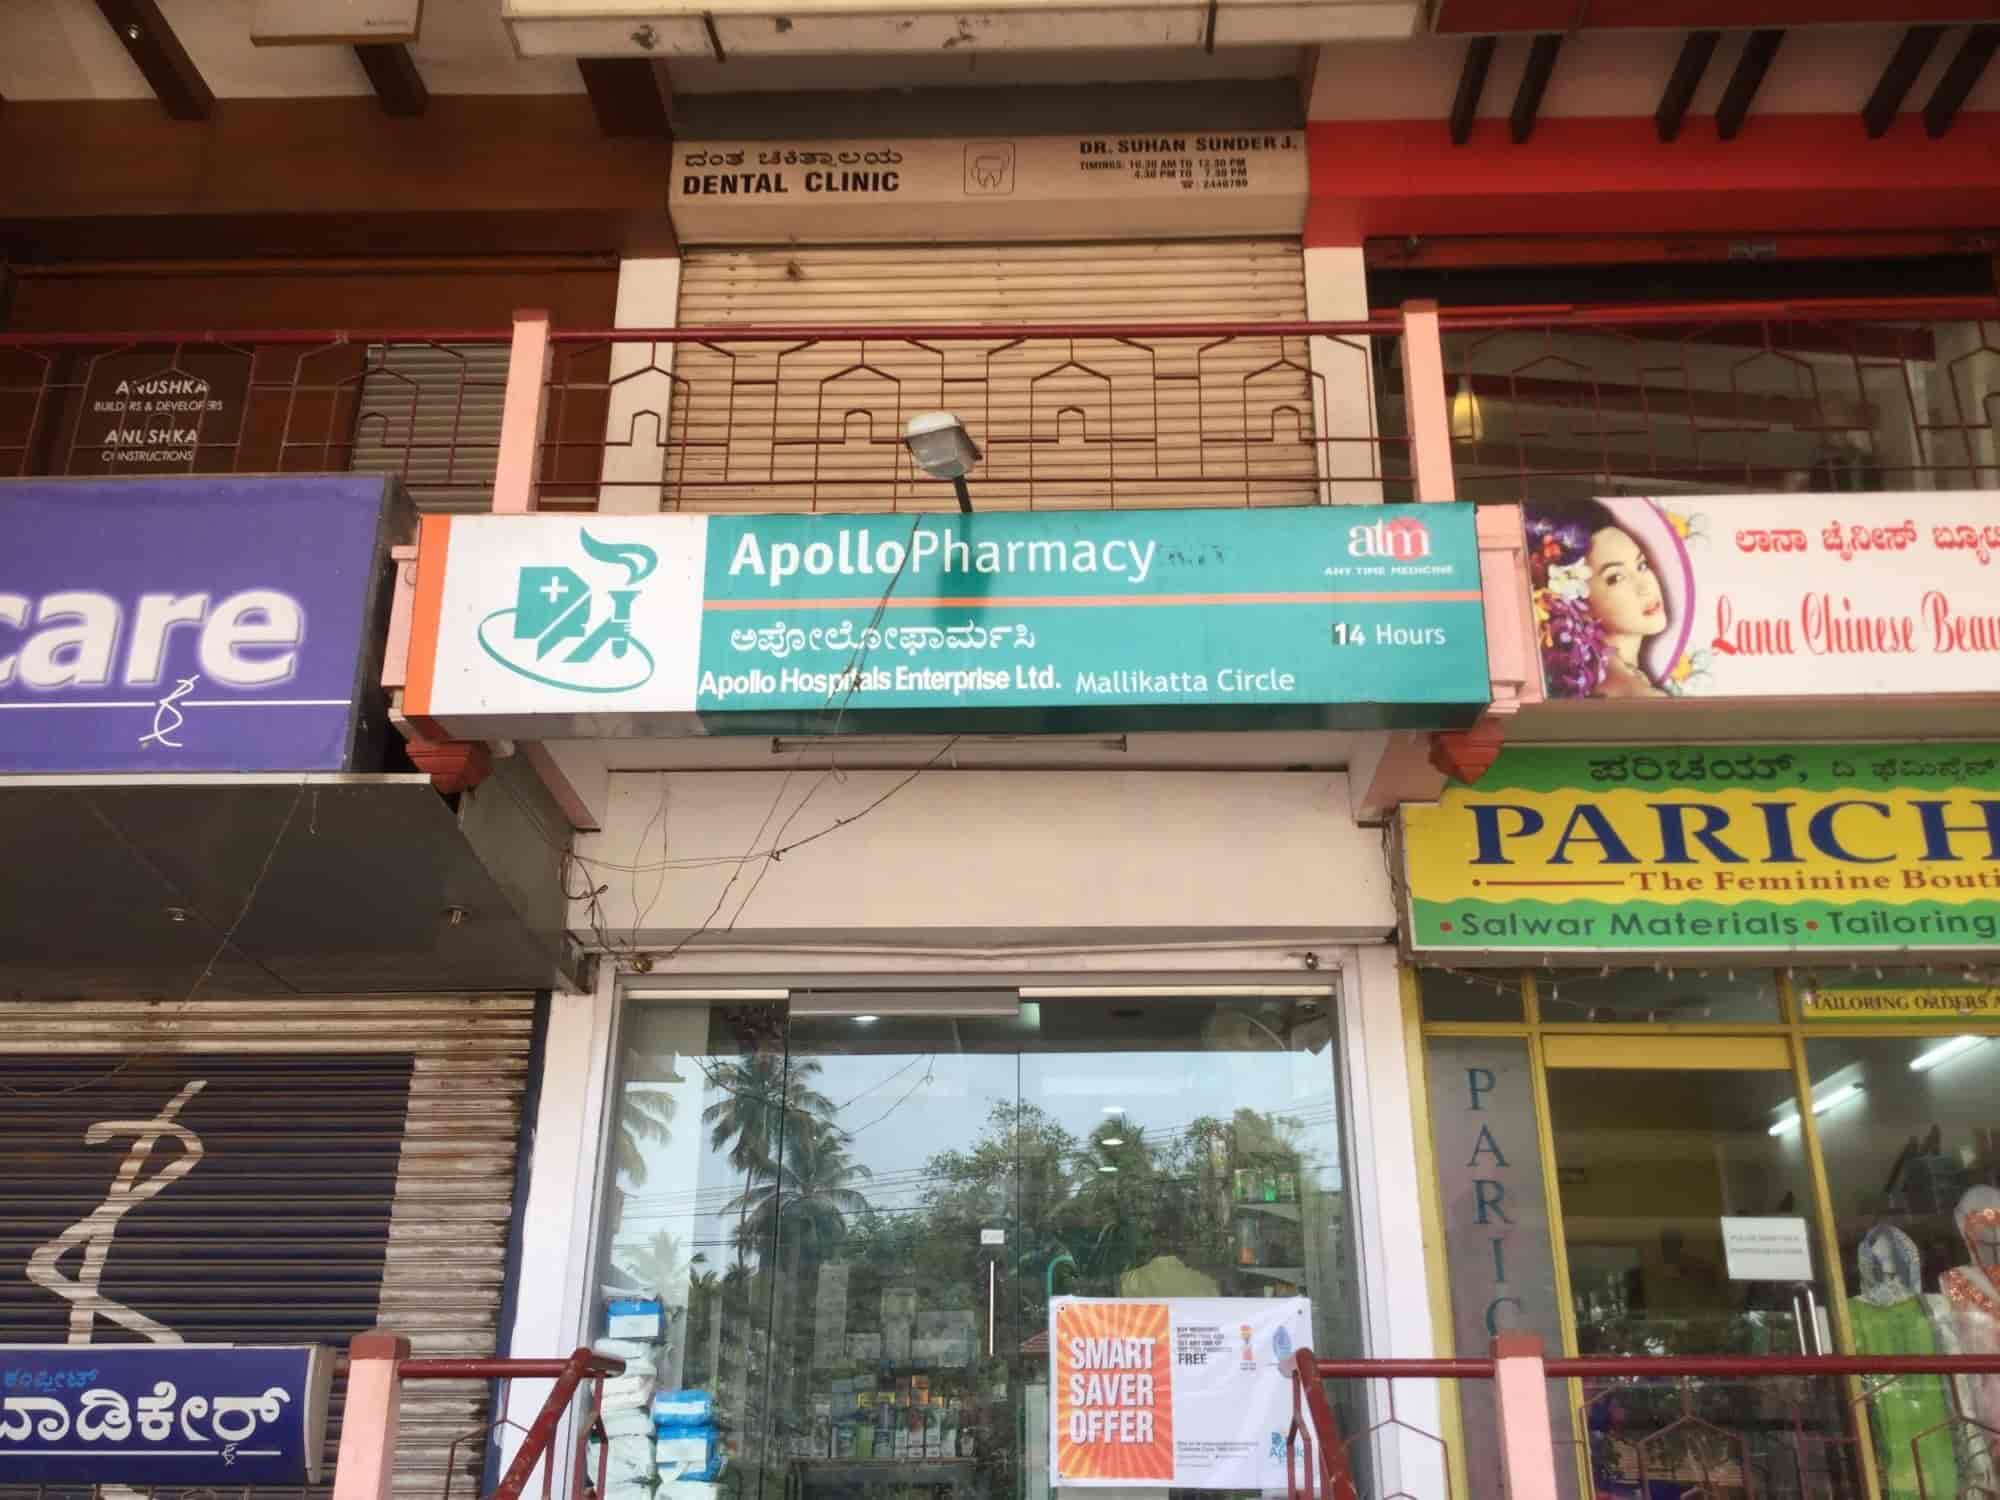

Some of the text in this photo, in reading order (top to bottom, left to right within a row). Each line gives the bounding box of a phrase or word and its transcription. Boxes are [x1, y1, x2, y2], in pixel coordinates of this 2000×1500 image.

[1079, 135, 1298, 154] DR. SUHAN SUNDER J.
[683, 171, 900, 195] DENTAL CLINIC
[1334, 624, 1446, 646] 14 Hours
[1711, 594, 1798, 656] Lana
[1800, 591, 1915, 656] Chinese
[699, 664, 1062, 699] Apollo Hospitals Enterprise Ltd.
[1075, 668, 1296, 694] Mallikatta Circle
[1631, 871, 1703, 891] The
[1715, 869, 1891, 891] Feminine
[1461, 910, 1997, 939] Salwar Materials Tailoring
[1069, 1336, 1157, 1371] SMART
[1177, 1352, 1208, 1366] FREE
[1069, 1373, 1155, 1408] SAVER
[1069, 1410, 1154, 1446] OFFER
